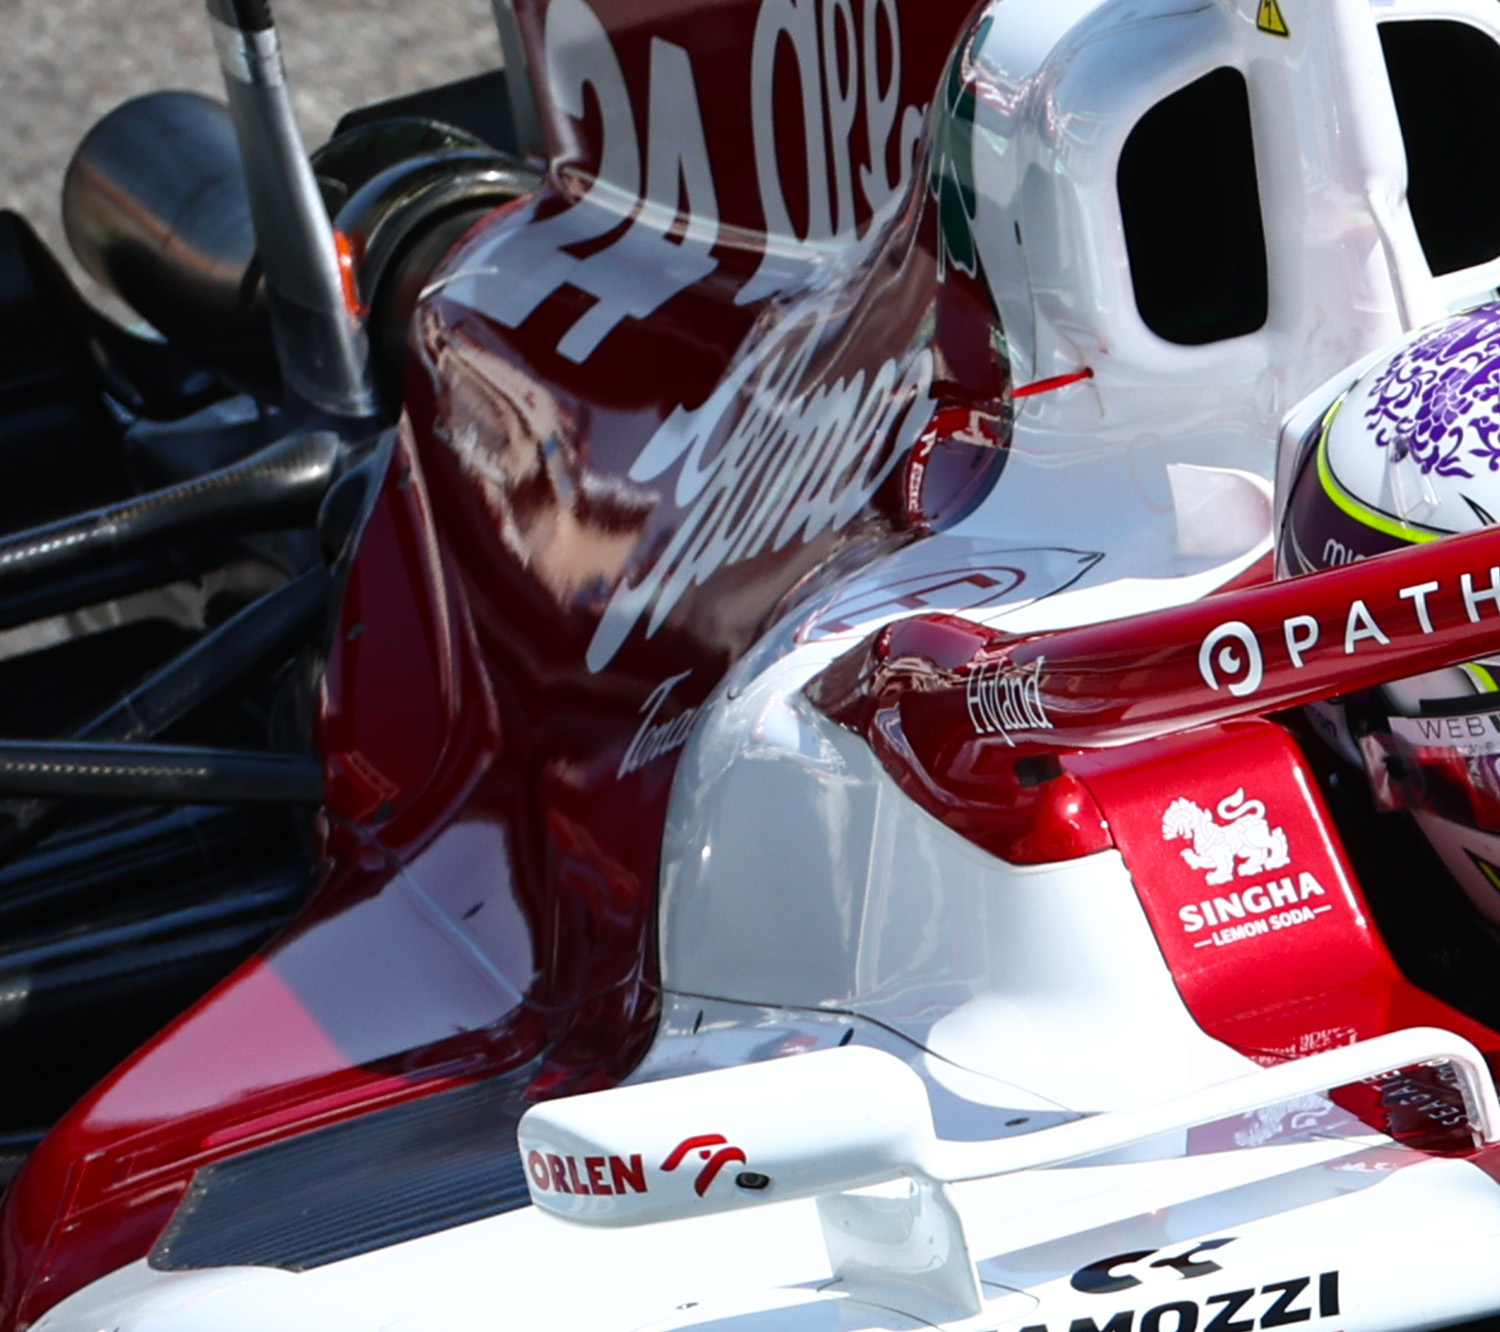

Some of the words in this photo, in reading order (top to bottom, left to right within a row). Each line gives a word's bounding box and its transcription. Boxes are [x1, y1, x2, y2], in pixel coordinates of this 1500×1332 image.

[1416, 715, 1486, 740] WEB
[1177, 870, 1327, 933] SINGHA
[1212, 920, 1266, 949] LEMON
[1268, 906, 1317, 935] SODA
[525, 1149, 647, 1198] ORLEN
